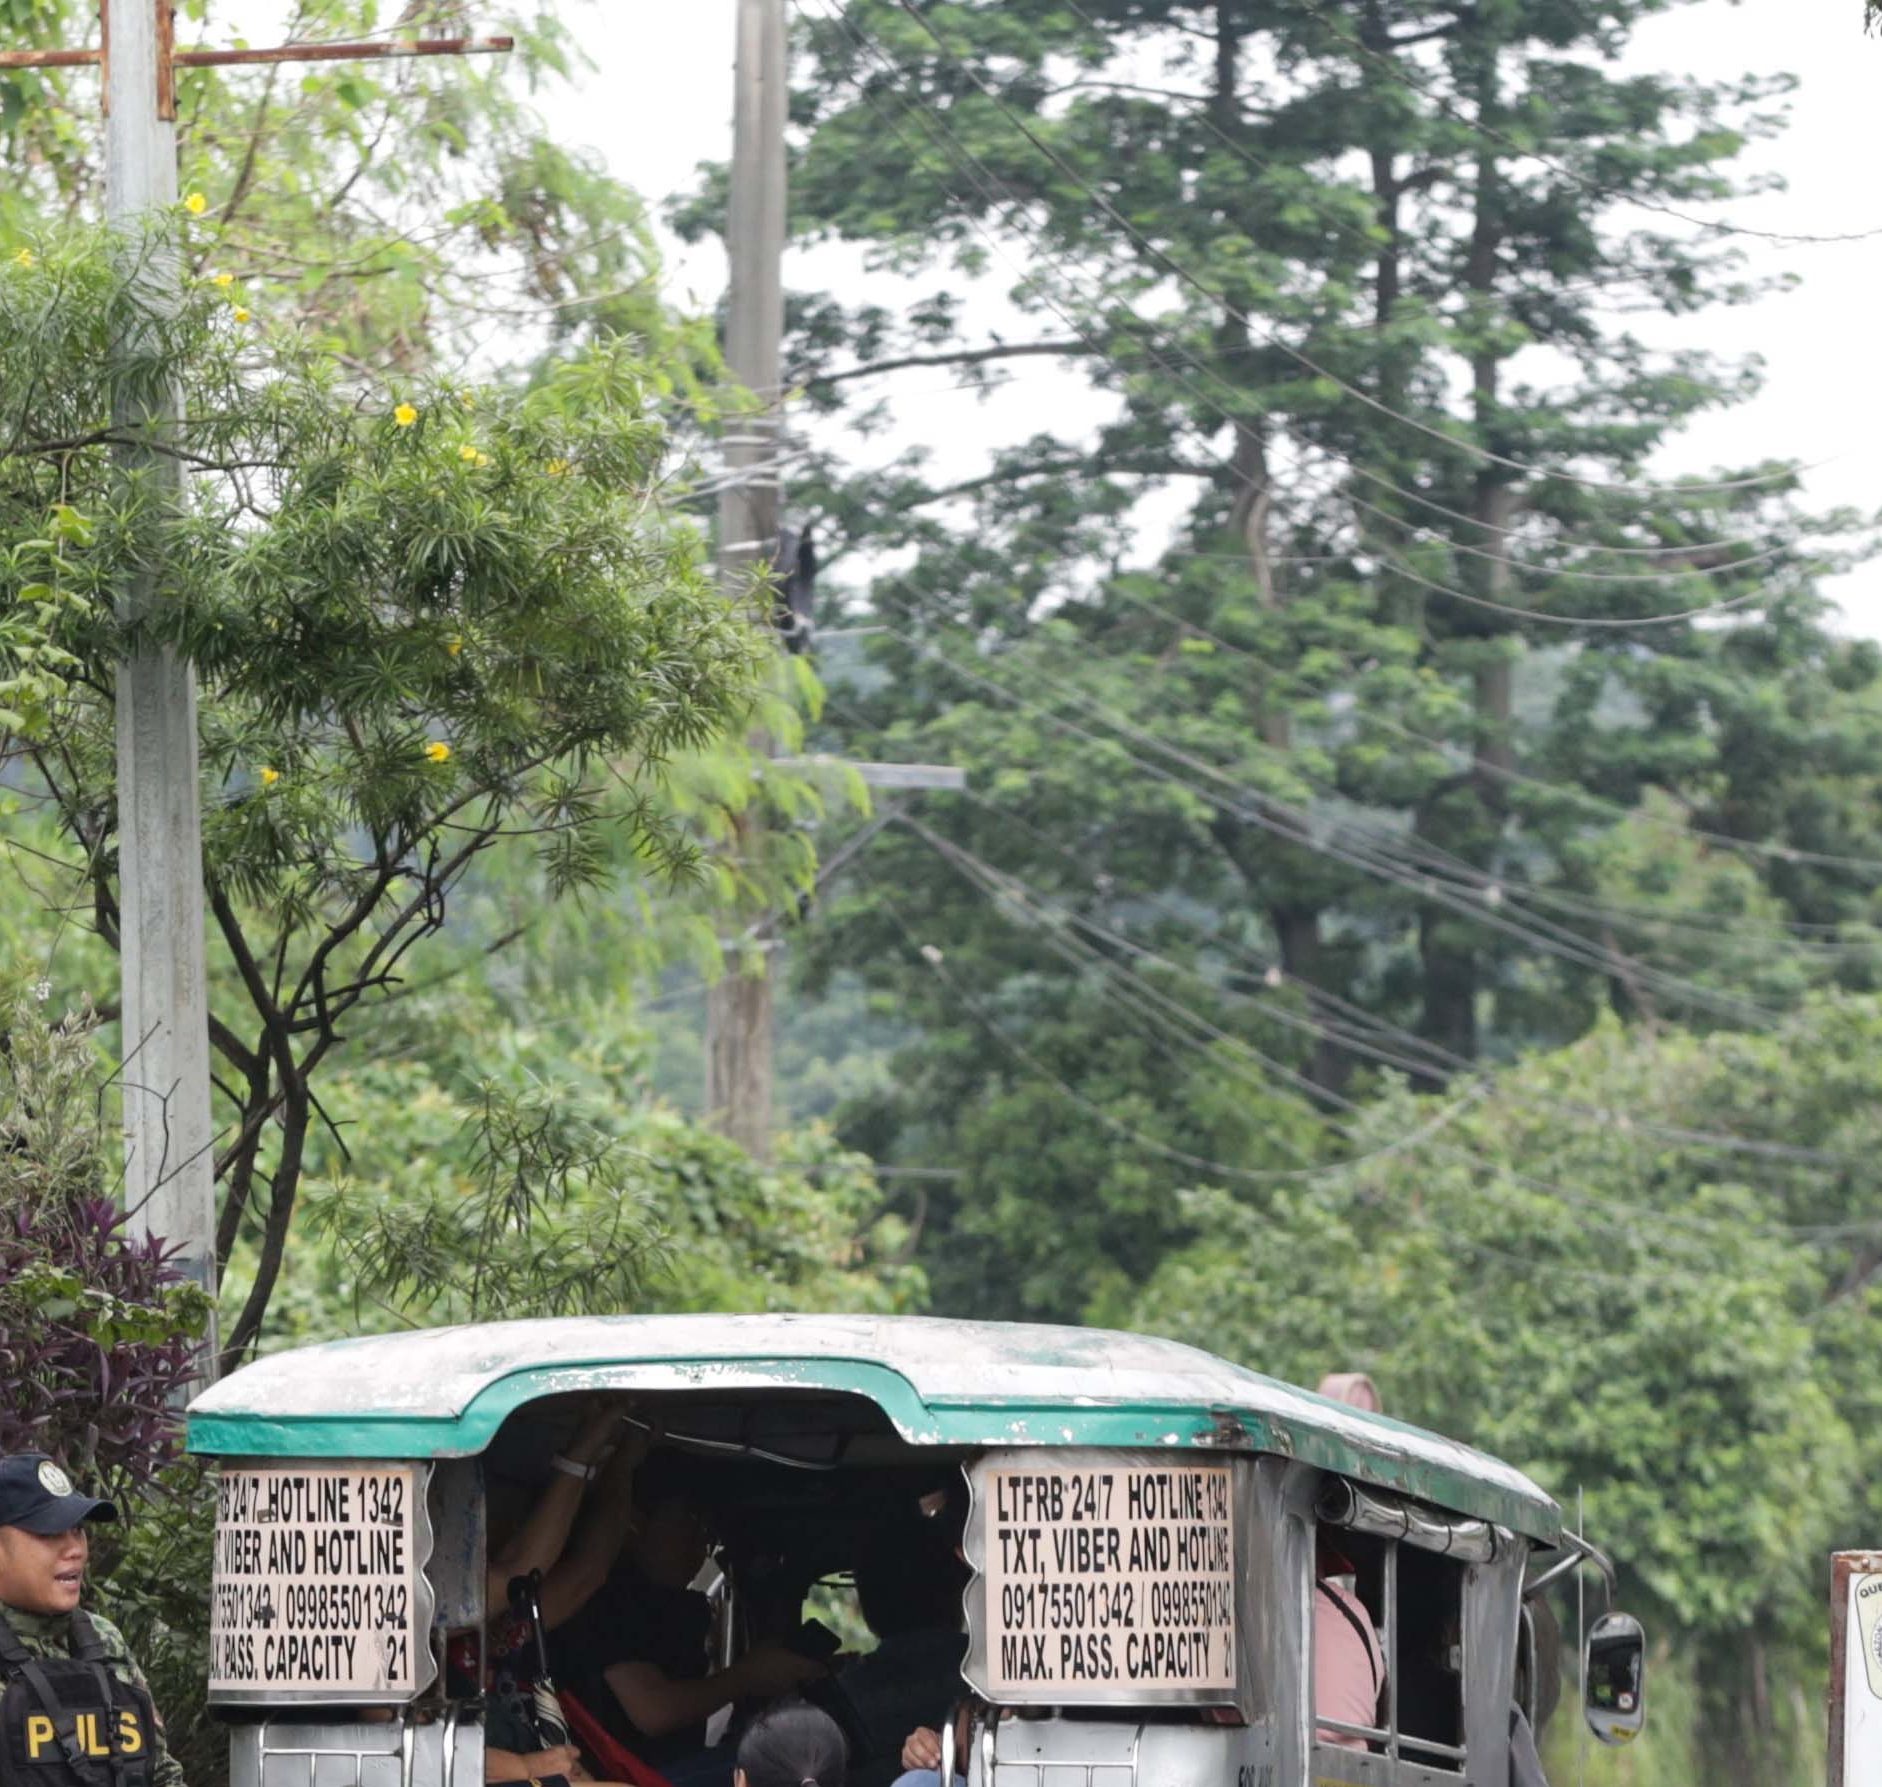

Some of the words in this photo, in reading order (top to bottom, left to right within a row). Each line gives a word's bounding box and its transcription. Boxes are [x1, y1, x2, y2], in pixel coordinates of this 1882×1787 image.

[269, 1476, 349, 1523] HOTLINE
[358, 1476, 404, 1524] 1342
[998, 1476, 1064, 1522] LTFRB
[1071, 1475, 1113, 1521] 24/7
[1128, 1475, 1203, 1521] HOTLINE
[1206, 1475, 1228, 1521] 1342
[225, 1530, 261, 1575] VIBER
[268, 1530, 306, 1575] AND
[314, 1530, 404, 1575] HOTLINE
[999, 1529, 1046, 1580] TXT,
[1053, 1527, 1120, 1573] VIBER
[1129, 1527, 1170, 1573] AND
[1177, 1526, 1229, 1573] HOTLINE
[286, 1584, 407, 1631] 09985501342
[1002, 1582, 1134, 1630] 09175501342
[1151, 1581, 1231, 1629] 09985501342
[225, 1635, 258, 1680] PASS.
[264, 1635, 356, 1681] CAPACITY
[387, 1635, 408, 1681] 21
[1001, 1634, 1053, 1681] MAX.
[1060, 1634, 1119, 1680] PASS.
[1126, 1632, 1209, 1679] CAPACITY
